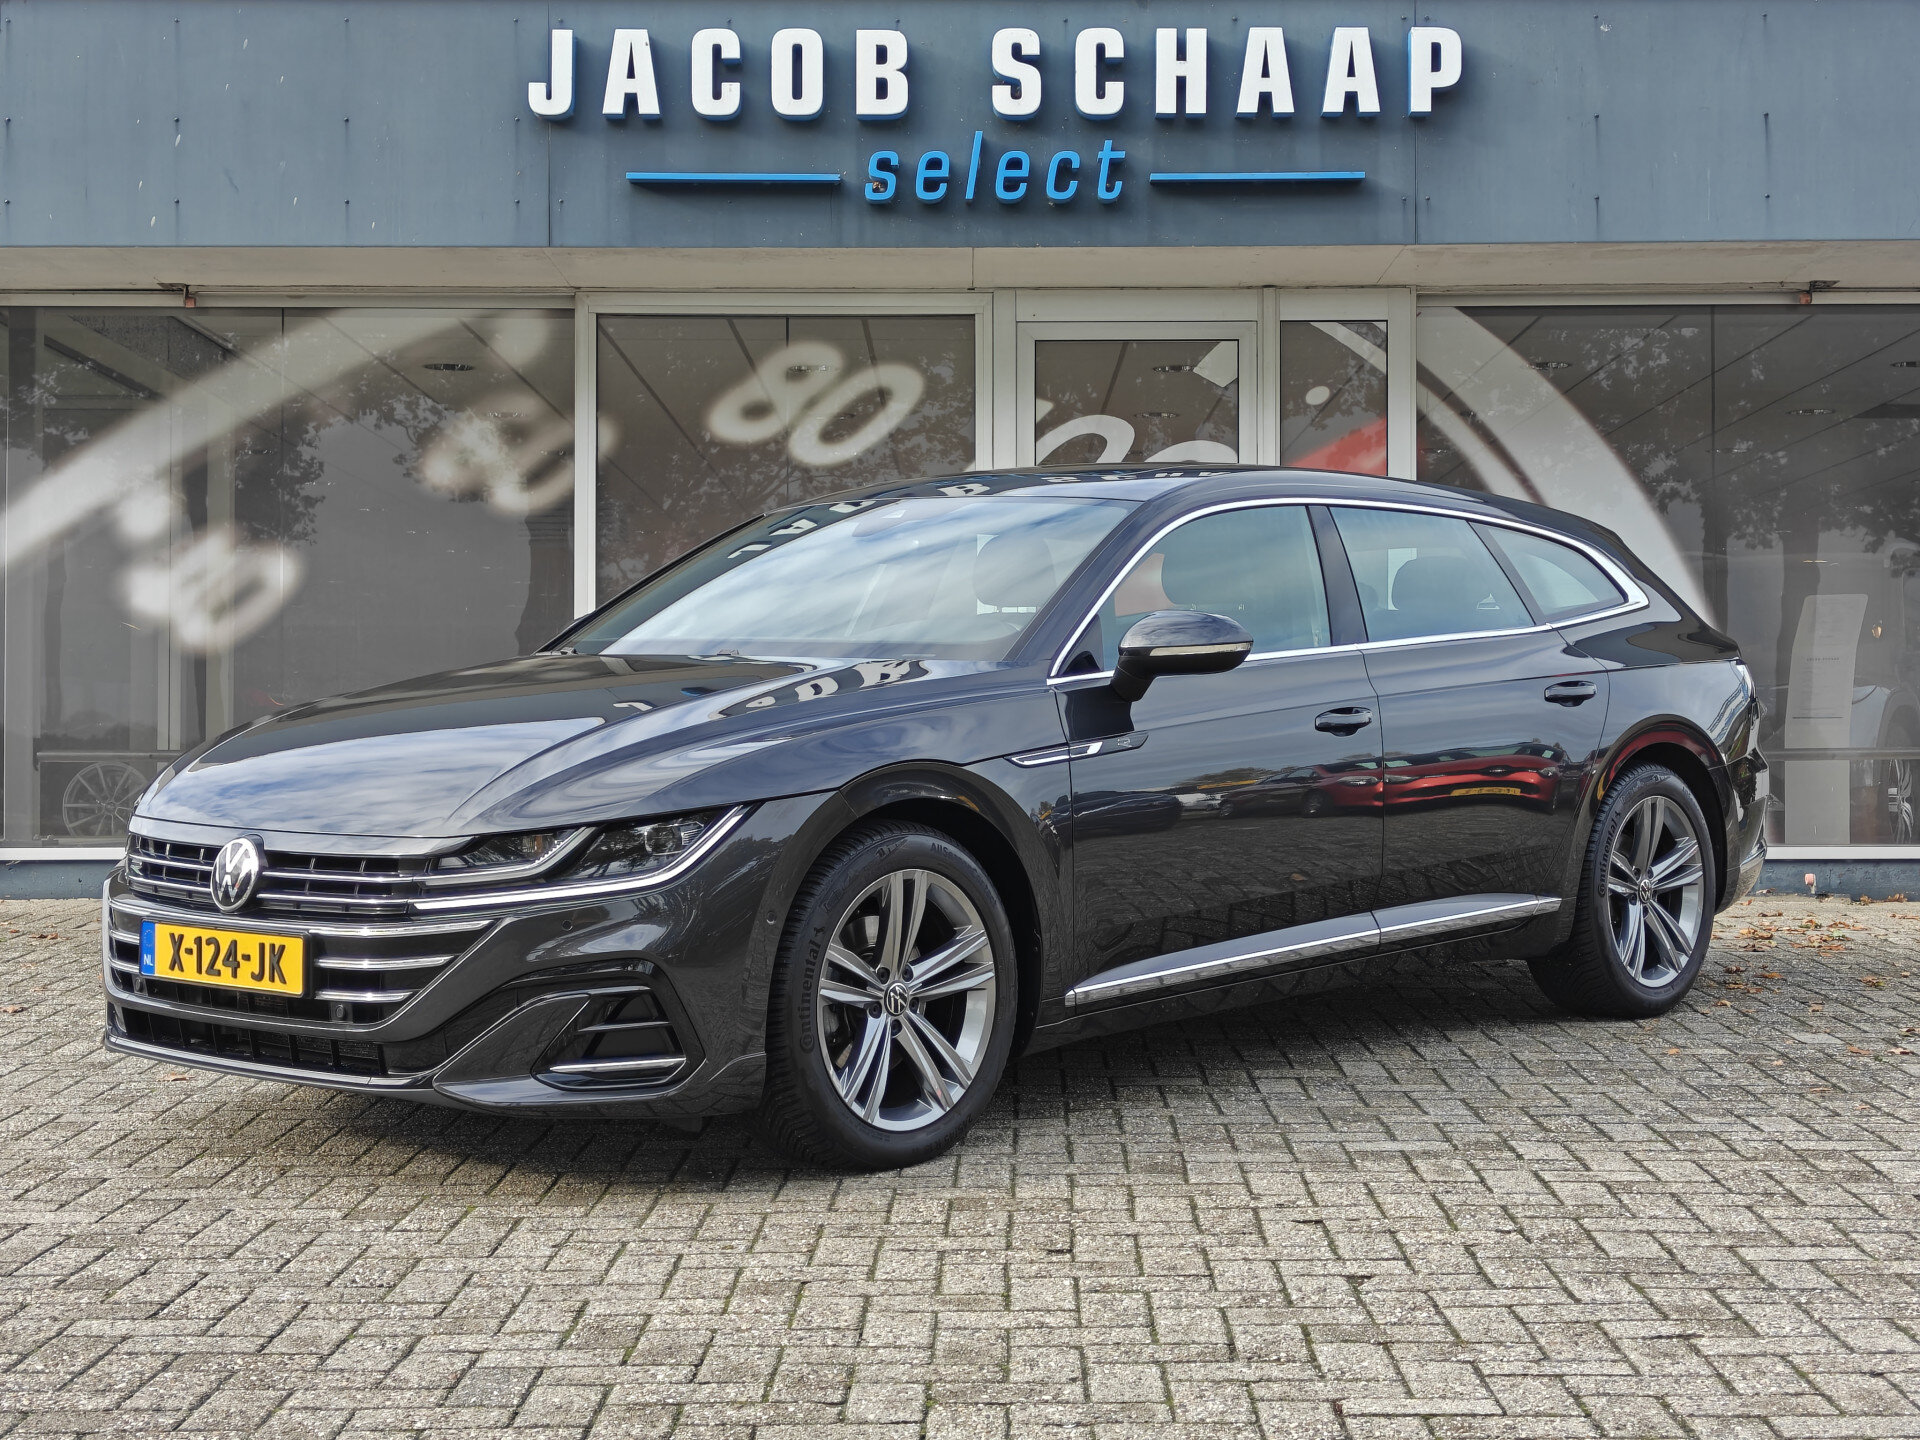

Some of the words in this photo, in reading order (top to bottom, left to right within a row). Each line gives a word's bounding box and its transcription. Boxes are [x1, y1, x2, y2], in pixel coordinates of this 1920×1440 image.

[528, 27, 910, 119] JACOB
[990, 26, 1463, 118] SCHAAP
[863, 130, 1126, 203] select
[143, 953, 154, 966] NL
[168, 932, 287, 985] X-124-JK
